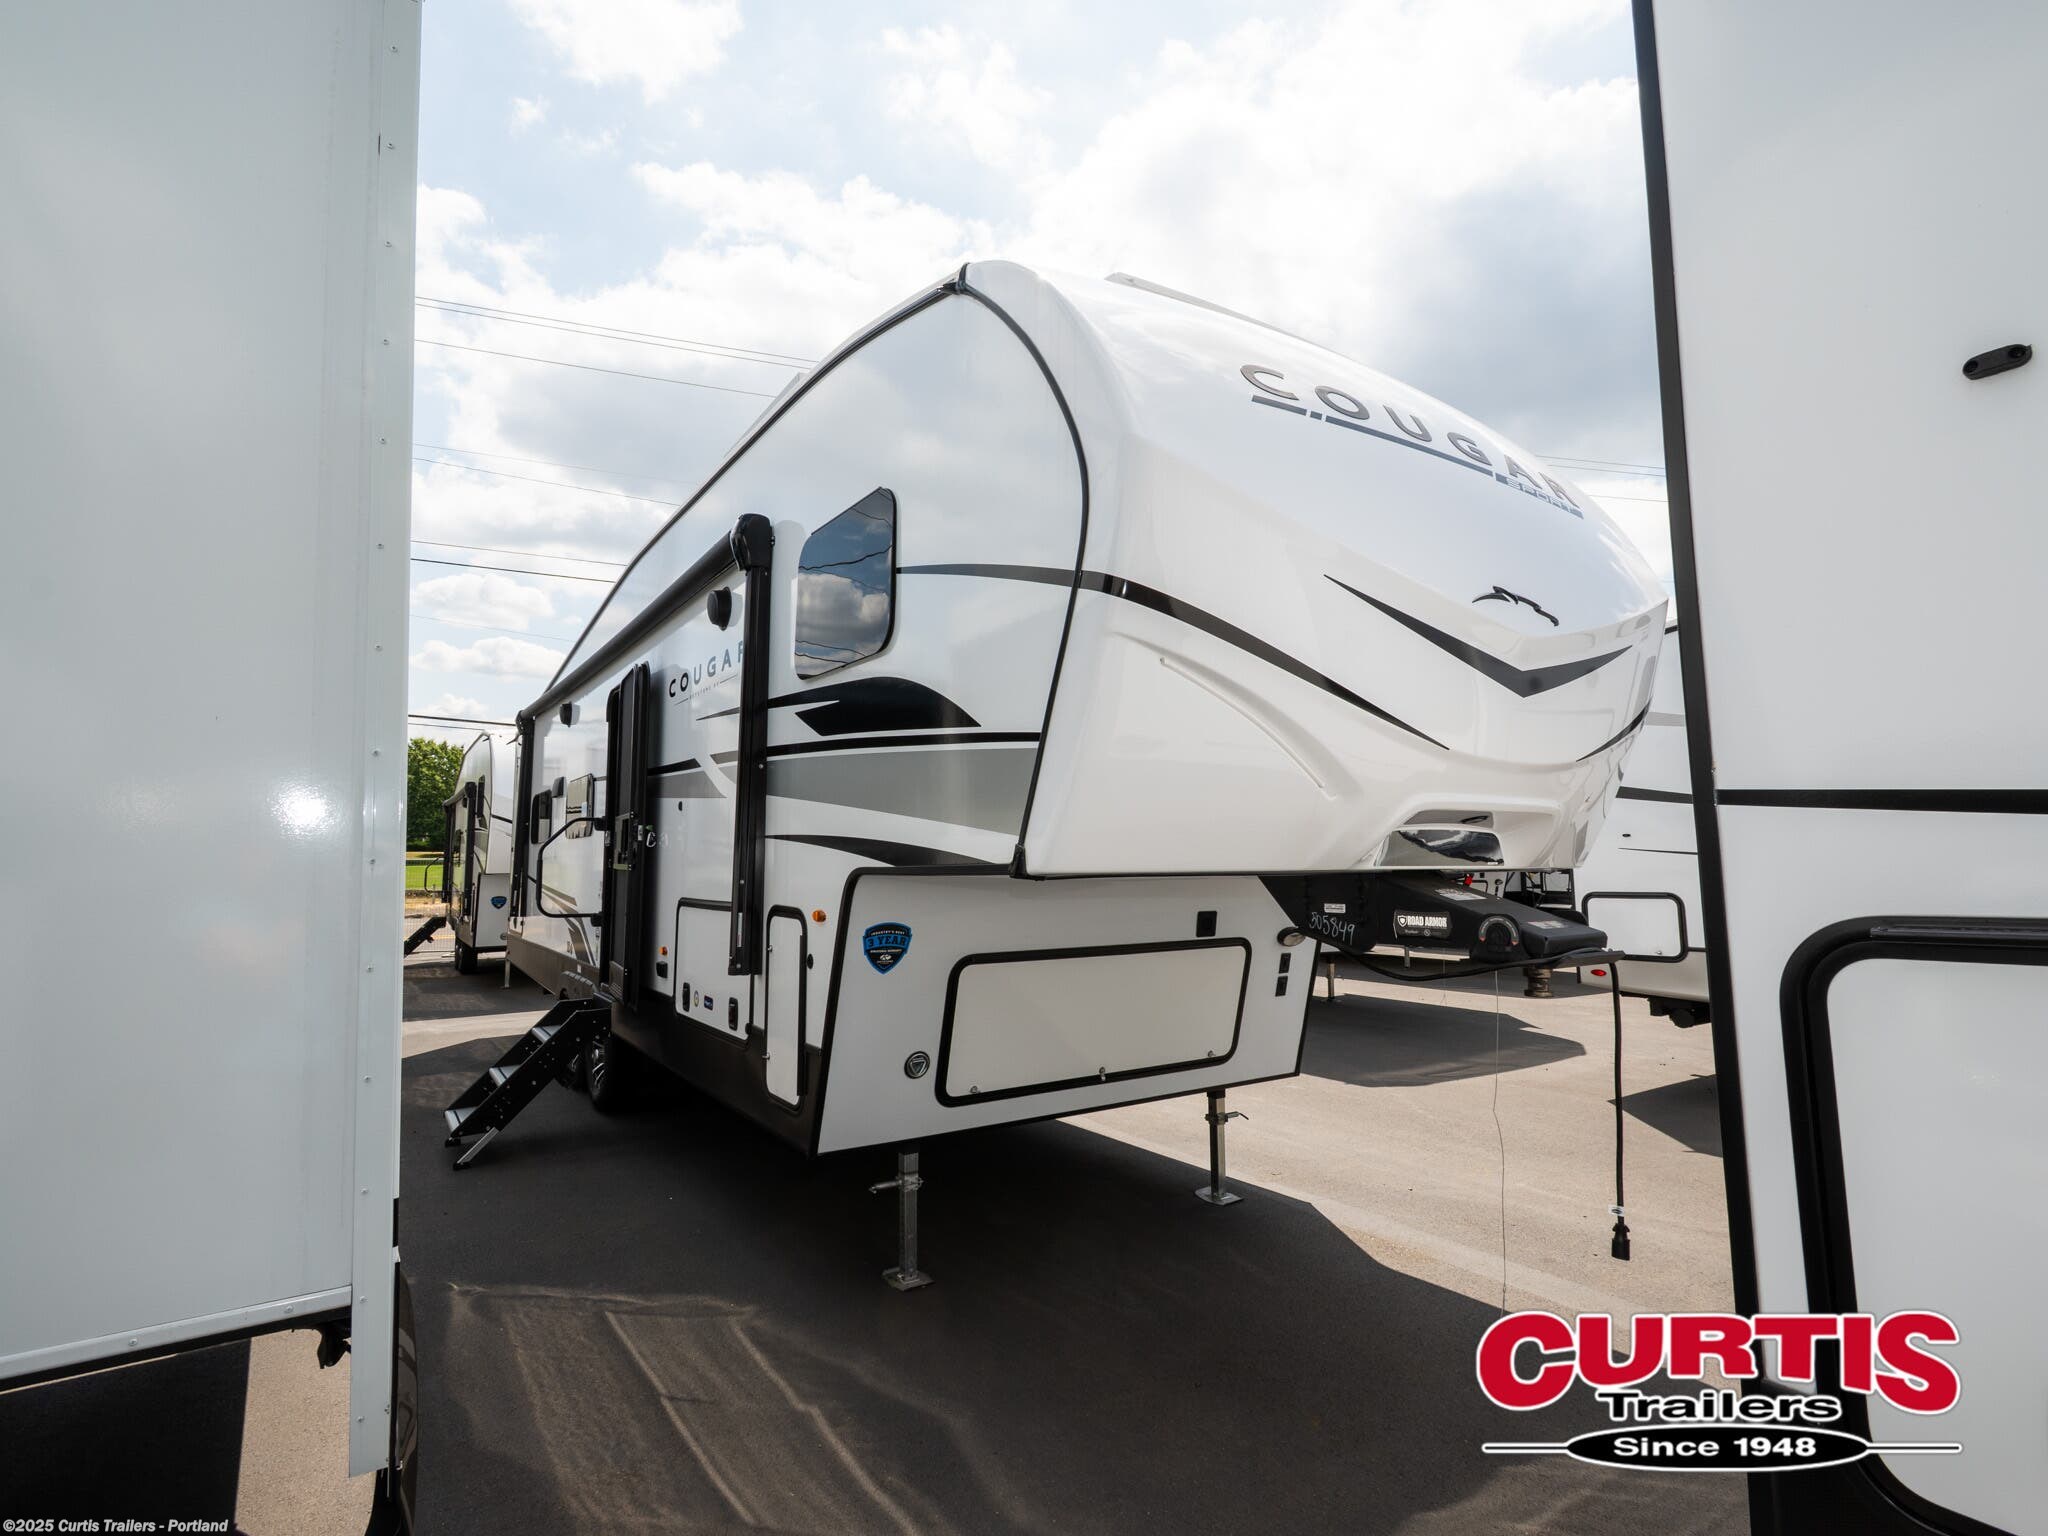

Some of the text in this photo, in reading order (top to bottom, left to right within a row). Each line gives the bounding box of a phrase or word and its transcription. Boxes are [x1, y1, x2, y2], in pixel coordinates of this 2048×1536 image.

[1240, 364, 1581, 509] COUGAR
[1407, 915, 1447, 928] ROAD ARMOR
[868, 935, 906, 947] 3 YEAR
